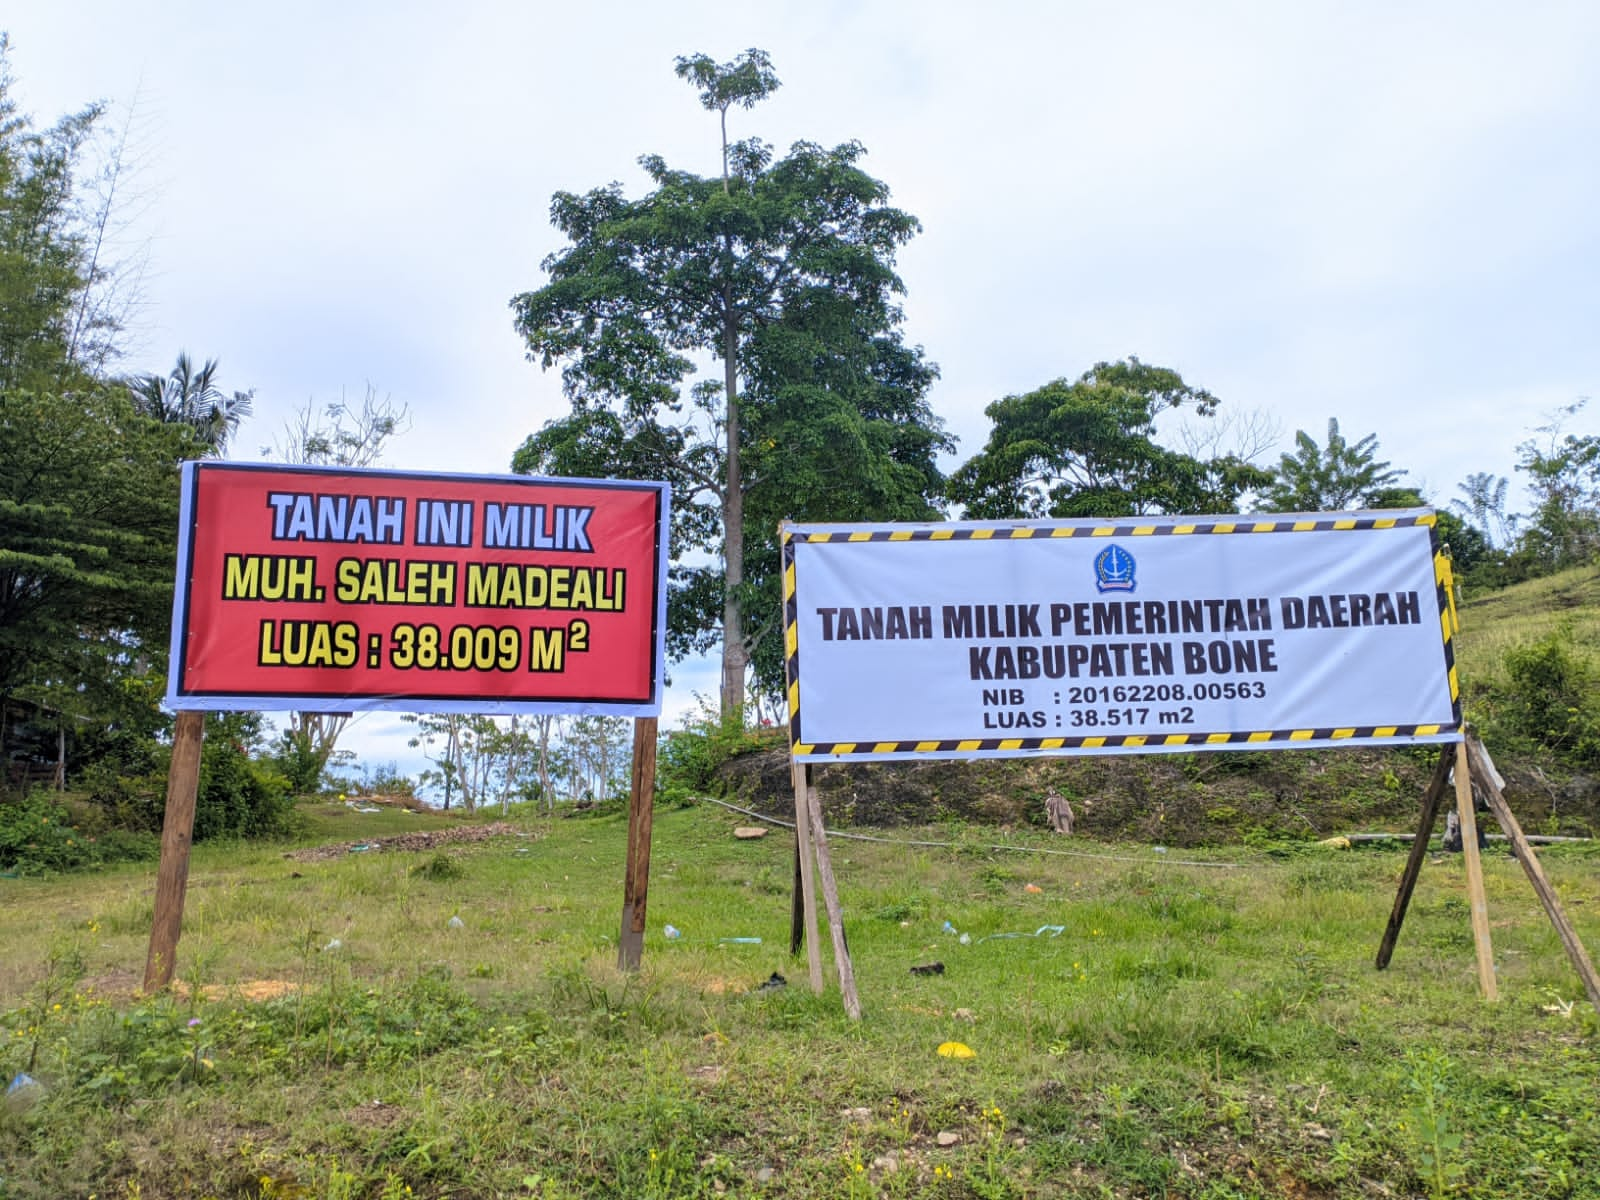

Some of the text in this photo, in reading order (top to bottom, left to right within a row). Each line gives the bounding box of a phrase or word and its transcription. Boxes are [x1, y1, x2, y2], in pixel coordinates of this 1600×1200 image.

[270, 494, 591, 550] TANAH INI MILIK
[225, 556, 623, 610] MUH. SALEH MADEALI
[816, 591, 1421, 641] TANAH MILIK PEMERINTAH DAERAH
[261, 622, 356, 666] LUAS
[393, 625, 519, 669] 38.009
[969, 638, 1278, 681] KABUPATEN BONE
[982, 688, 1025, 706] NIB
[1068, 681, 1266, 704] 20162208.00563
[983, 711, 1047, 729] LUAS
[1070, 708, 1150, 727] 38.517
[1158, 706, 1195, 725] m2
